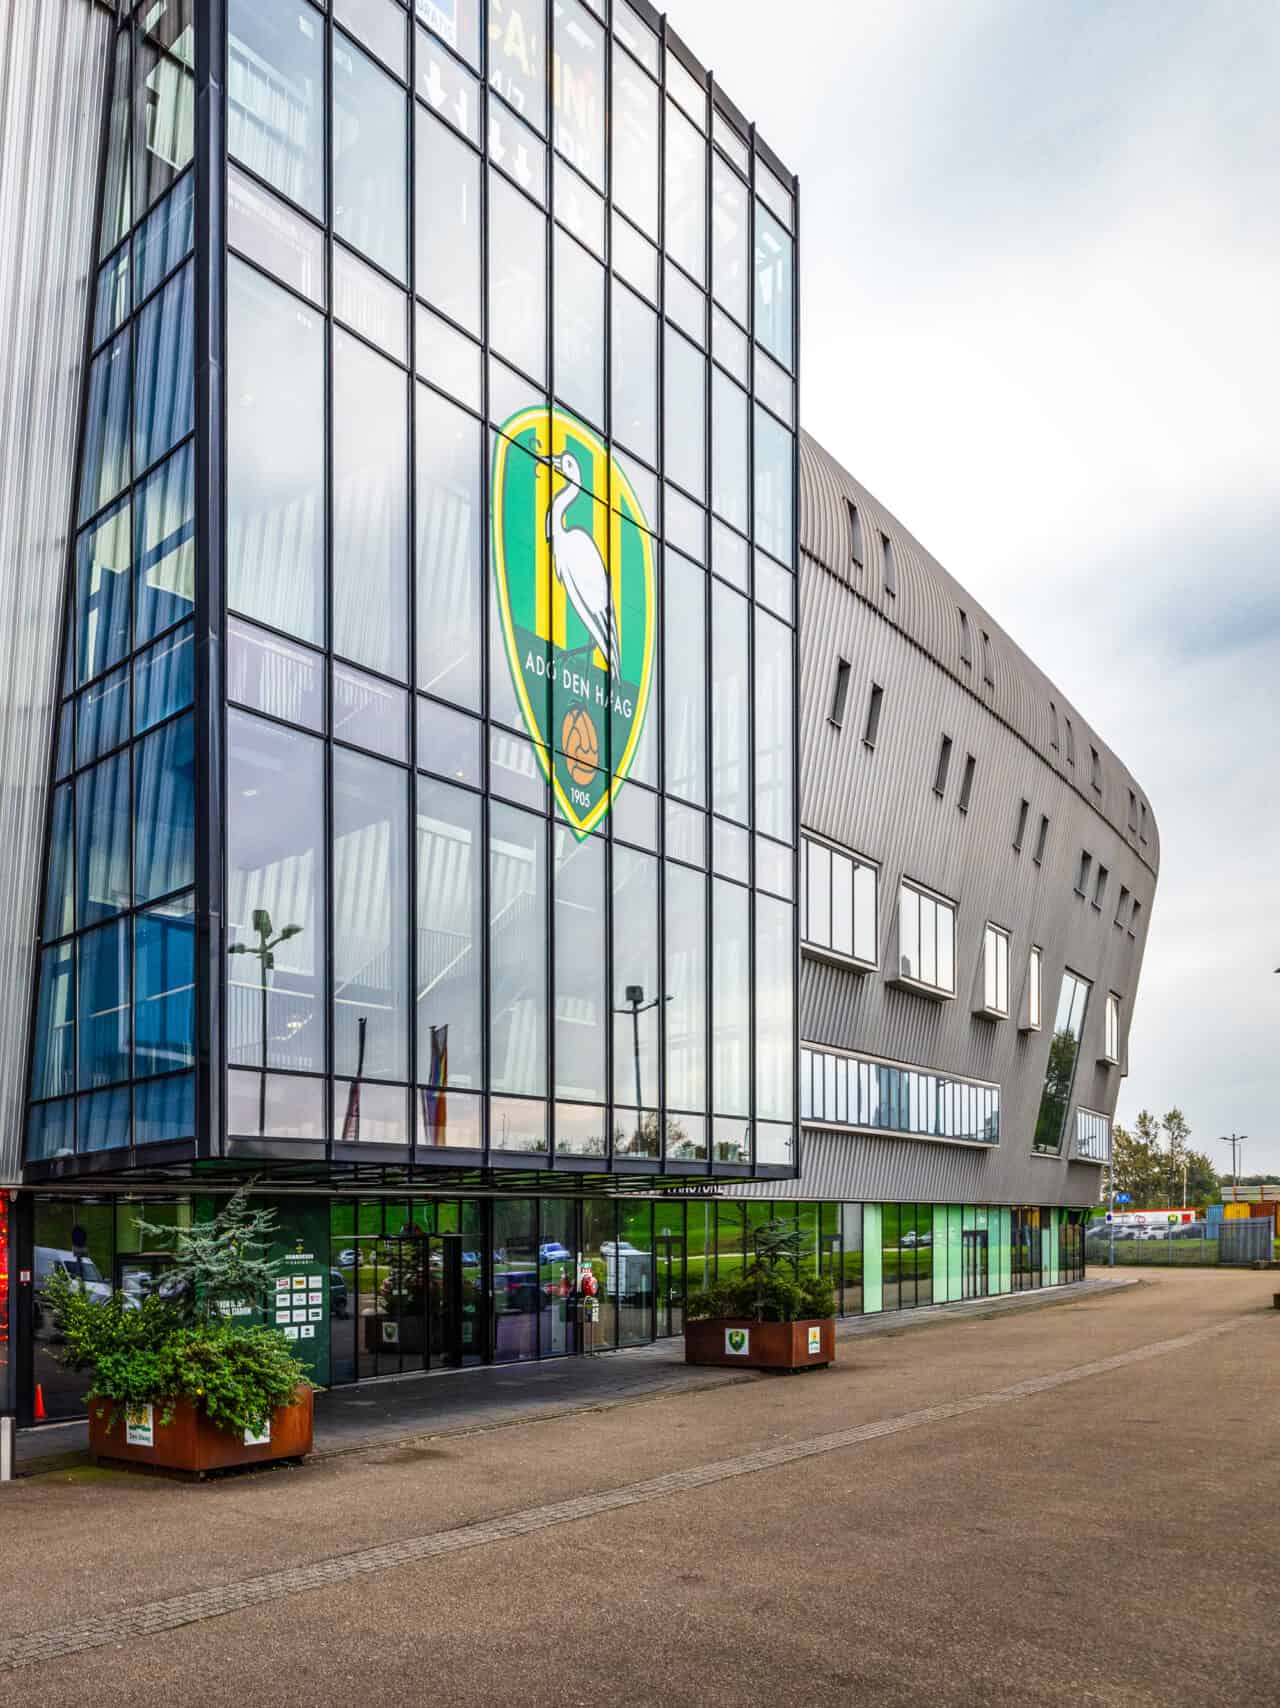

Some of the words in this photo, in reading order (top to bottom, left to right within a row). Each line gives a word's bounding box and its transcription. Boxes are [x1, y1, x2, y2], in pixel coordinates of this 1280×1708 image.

[525, 650, 557, 680] ADO
[563, 669, 590, 701] DEN
[570, 787, 591, 808] 1905
